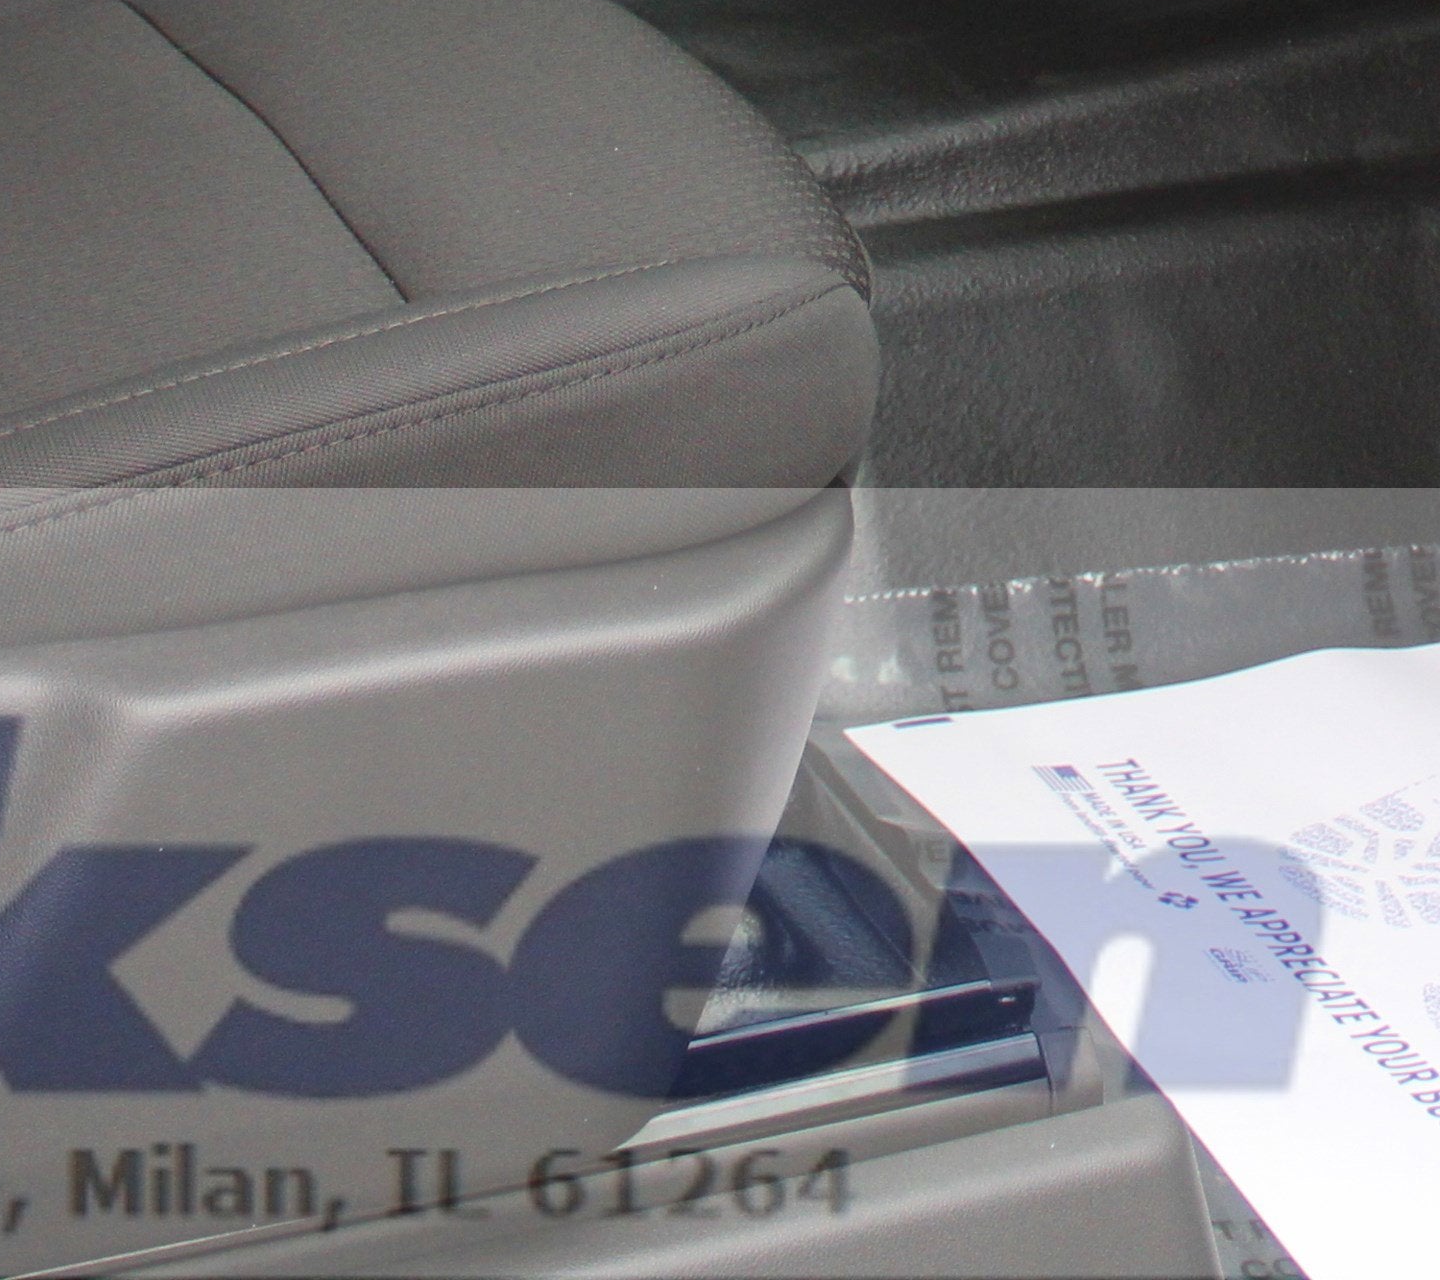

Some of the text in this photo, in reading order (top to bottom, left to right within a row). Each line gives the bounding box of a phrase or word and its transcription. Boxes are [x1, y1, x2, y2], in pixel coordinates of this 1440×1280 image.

[1096, 758, 1187, 822] THANK
[1155, 821, 1227, 870] YOU,
[1200, 870, 1263, 903] WE
[1230, 906, 1381, 1025] APPRECIATE
[1349, 1024, 1440, 1086] YOUR
